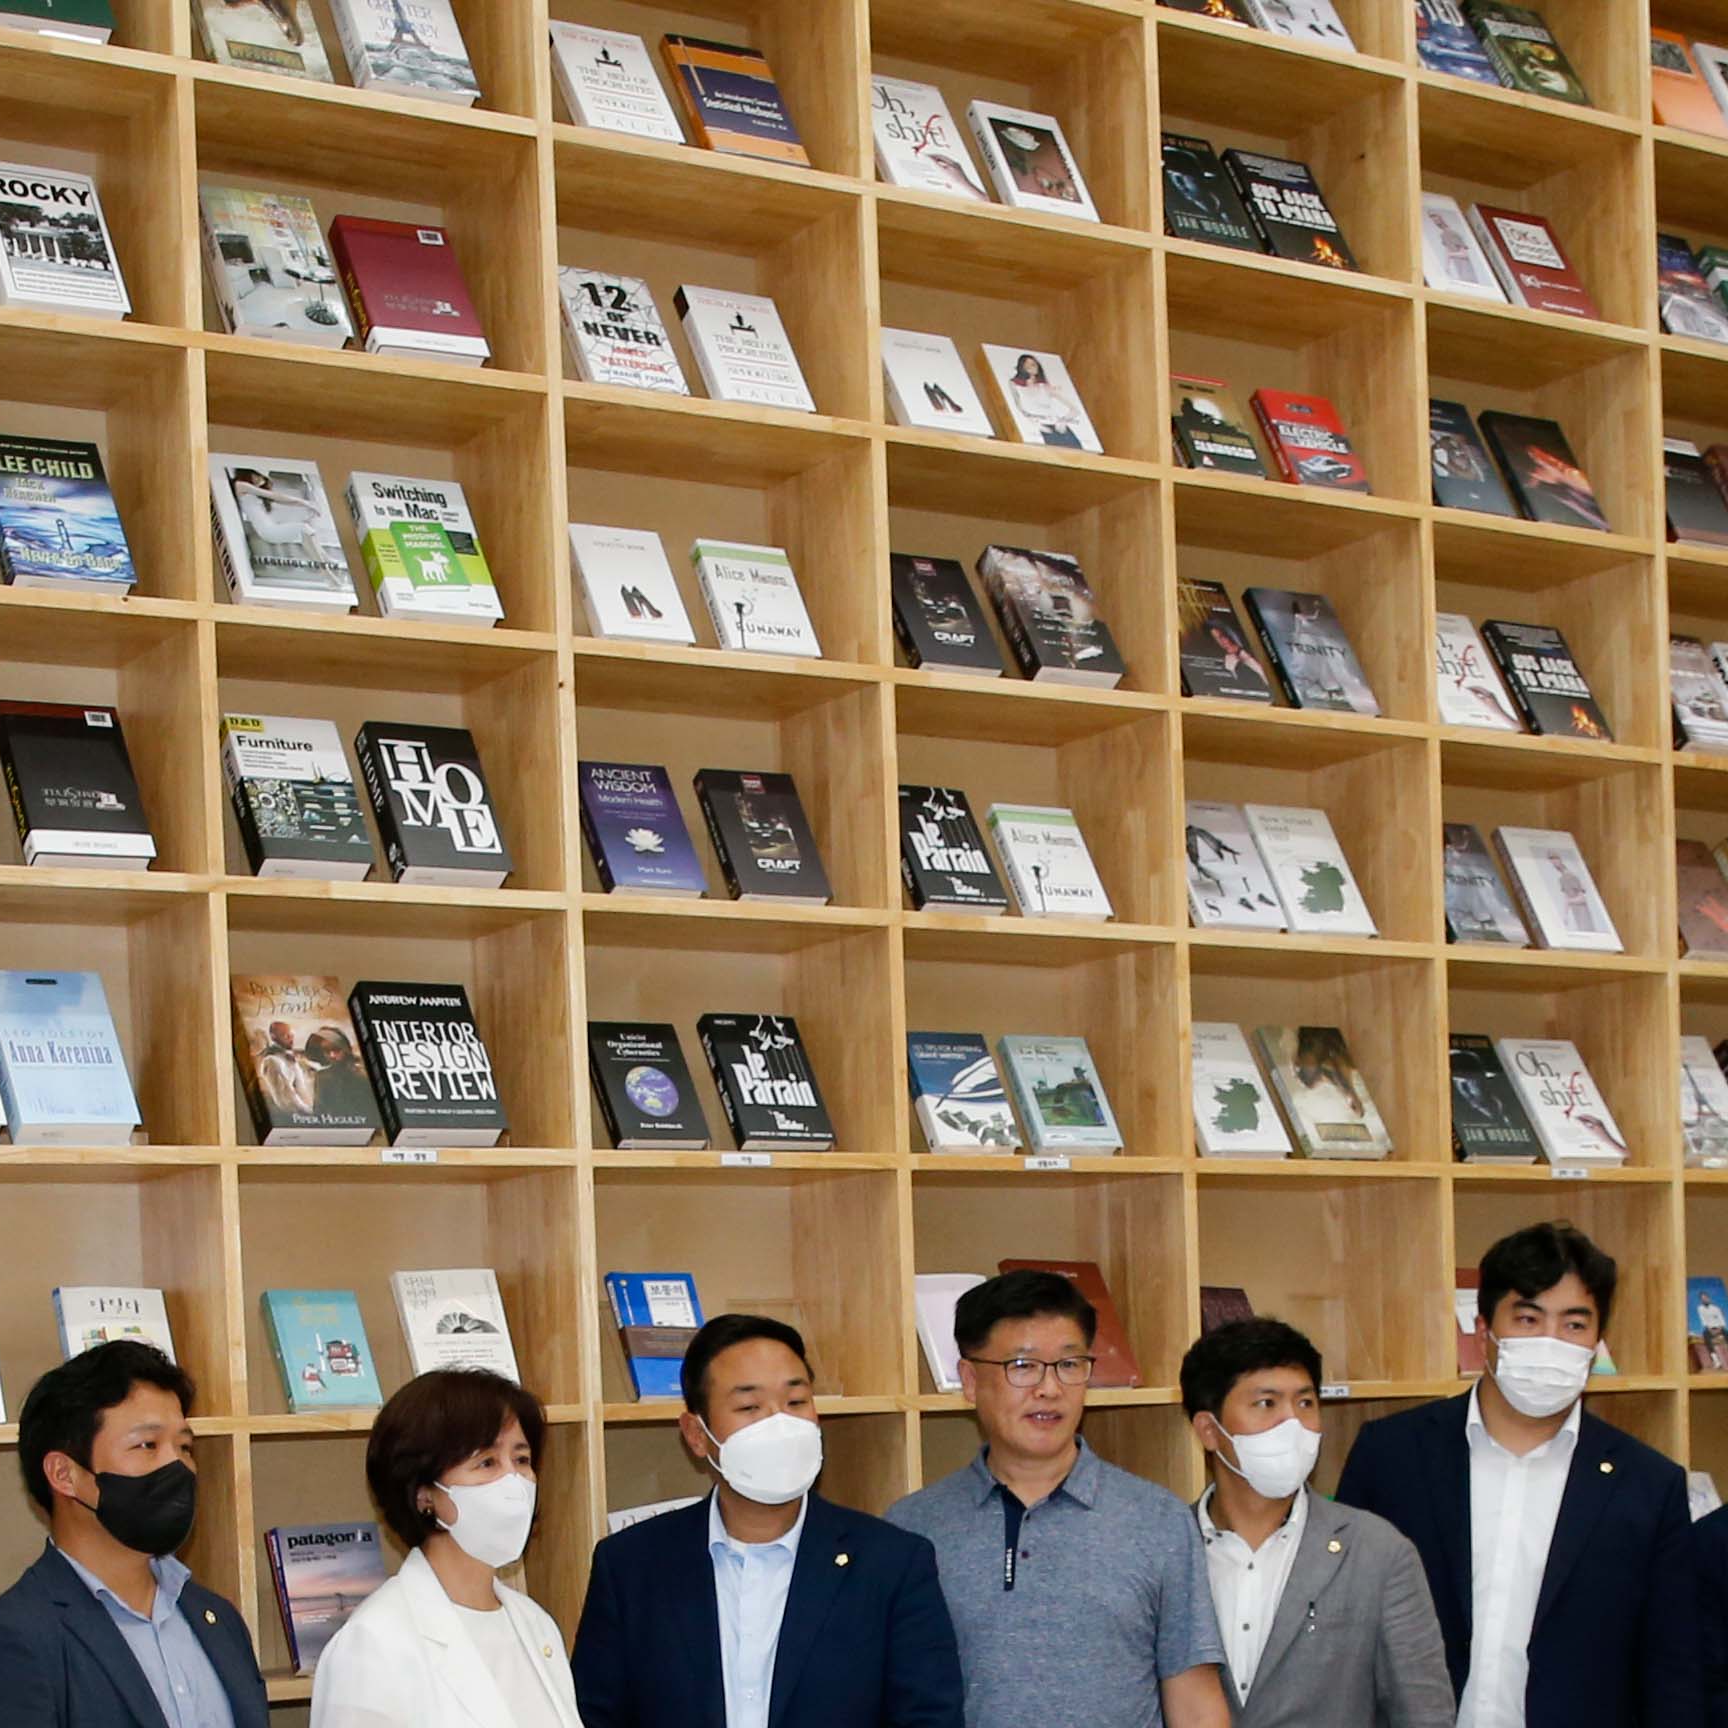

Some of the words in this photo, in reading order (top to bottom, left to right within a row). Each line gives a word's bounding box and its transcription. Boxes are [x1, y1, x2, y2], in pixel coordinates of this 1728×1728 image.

[606, 310, 626, 324] OF
[582, 320, 662, 348] NEVER
[30, 457, 95, 481] CHILD
[371, 481, 448, 509] Switching
[374, 505, 386, 516] to
[387, 506, 404, 518] the
[405, 502, 441, 521] Mac
[408, 524, 428, 533] THE
[714, 564, 745, 582] Alice
[934, 631, 976, 645] CRAFT
[1286, 641, 1348, 659] TRINITY
[236, 734, 314, 753] Furniture
[590, 767, 652, 783] ANCIENT
[594, 779, 657, 794] WISDOM
[916, 813, 945, 849] le
[1011, 829, 1039, 845] Alice
[908, 831, 991, 874] Parrain
[756, 858, 801, 871] CRAFT
[368, 994, 418, 1007] ANDREW
[419, 996, 462, 1008] MARTIN
[370, 1019, 475, 1045] INTERIOR
[8, 1039, 45, 1065] Anna
[47, 1040, 113, 1065] Karenina
[379, 1041, 492, 1073] DESIGN
[742, 1043, 770, 1081] le
[1514, 1050, 1562, 1079] Oh,
[385, 1068, 498, 1101] REVIEW
[730, 1061, 818, 1107] Parrain
[292, 1112, 320, 1124] PIPER
[321, 1113, 368, 1126] HUGULEY
[287, 1528, 373, 1550] patagonia
